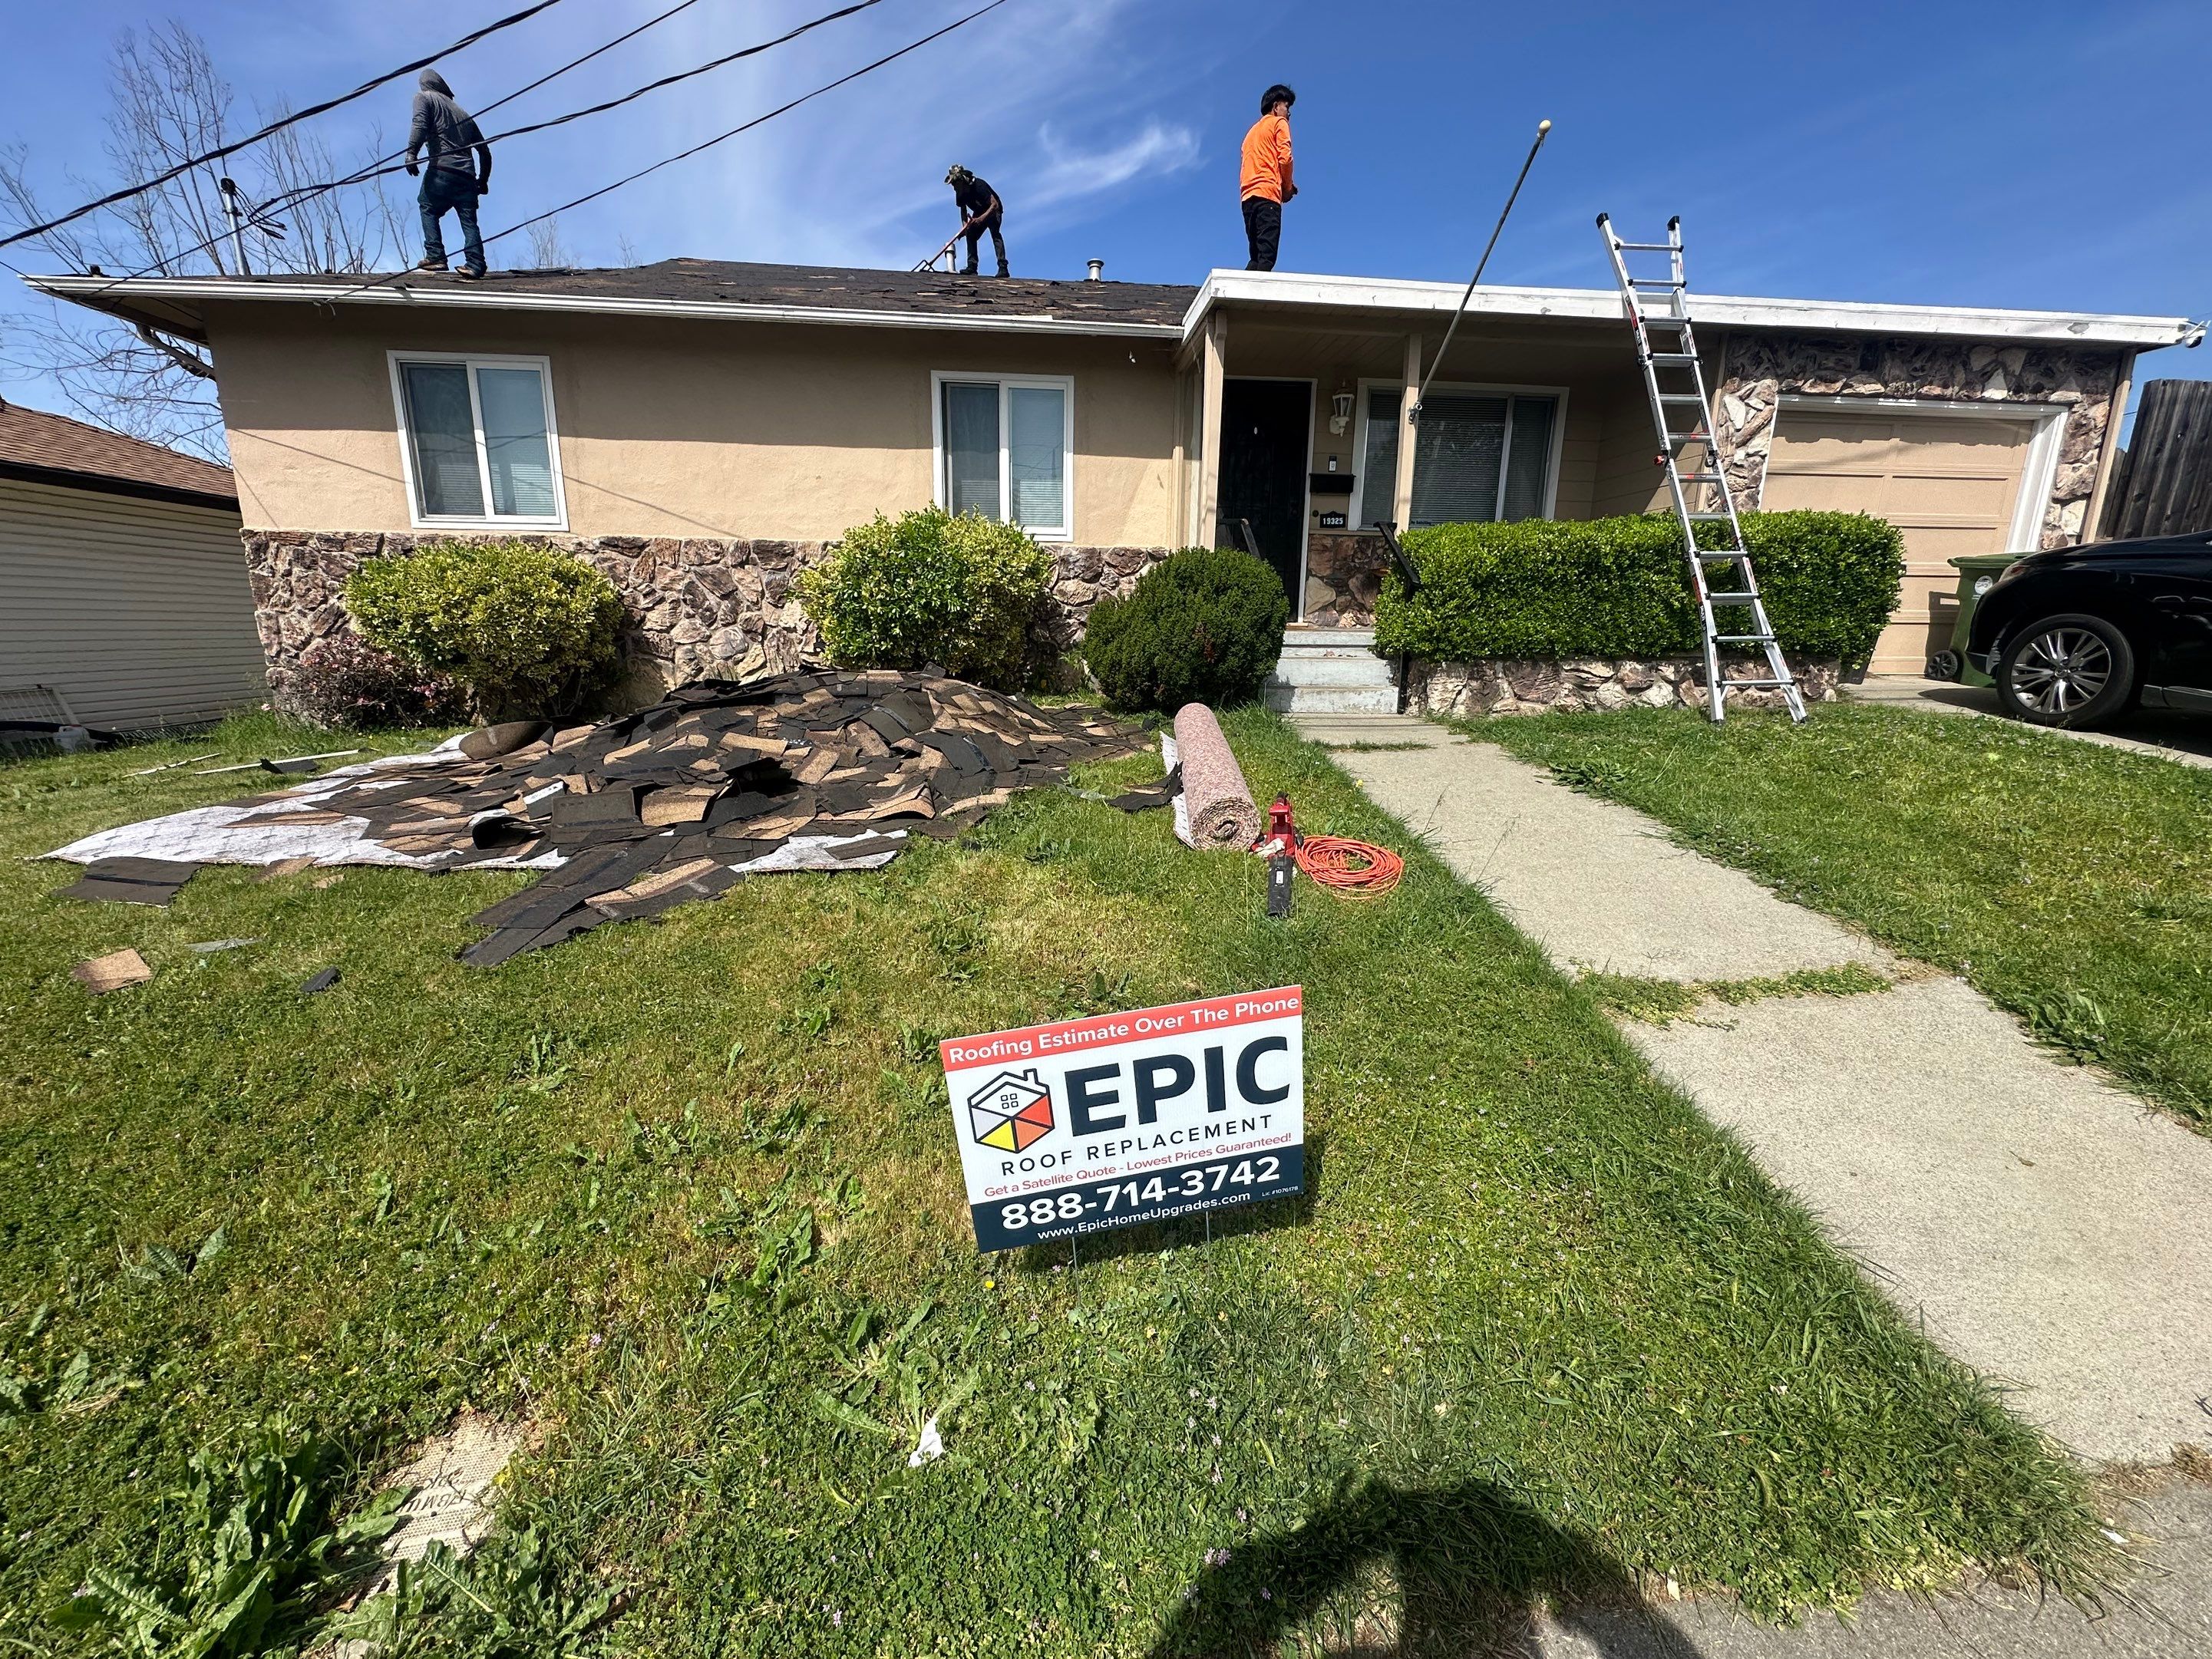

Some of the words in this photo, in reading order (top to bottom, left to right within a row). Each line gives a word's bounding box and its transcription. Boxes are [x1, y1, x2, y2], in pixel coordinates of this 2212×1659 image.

[949, 1037, 1033, 1064] Roofing
[1038, 1024, 1130, 1050] Estimate
[1135, 1014, 1185, 1034] Over
[1190, 1007, 1230, 1024] The
[1235, 997, 1299, 1018] Phone
[1065, 1036, 1290, 1137] EPIC
[984, 1184, 1009, 1198] Get
[1012, 1184, 1020, 1192] a
[1022, 1173, 1074, 1189] Satellite
[1076, 1165, 1117, 1179] Quote
[1127, 1154, 1172, 1171] Lowest
[1175, 1148, 1213, 1162] Prices
[1216, 1133, 1292, 1153] Guaranteed!
[1001, 1151, 1074, 1177] ROOF
[1086, 1114, 1273, 1161] REPLACEMENT
[1001, 1156, 1281, 1230] 888-714-3742
[1037, 1191, 1251, 1240] www.EpicHomeUpgrades.com
